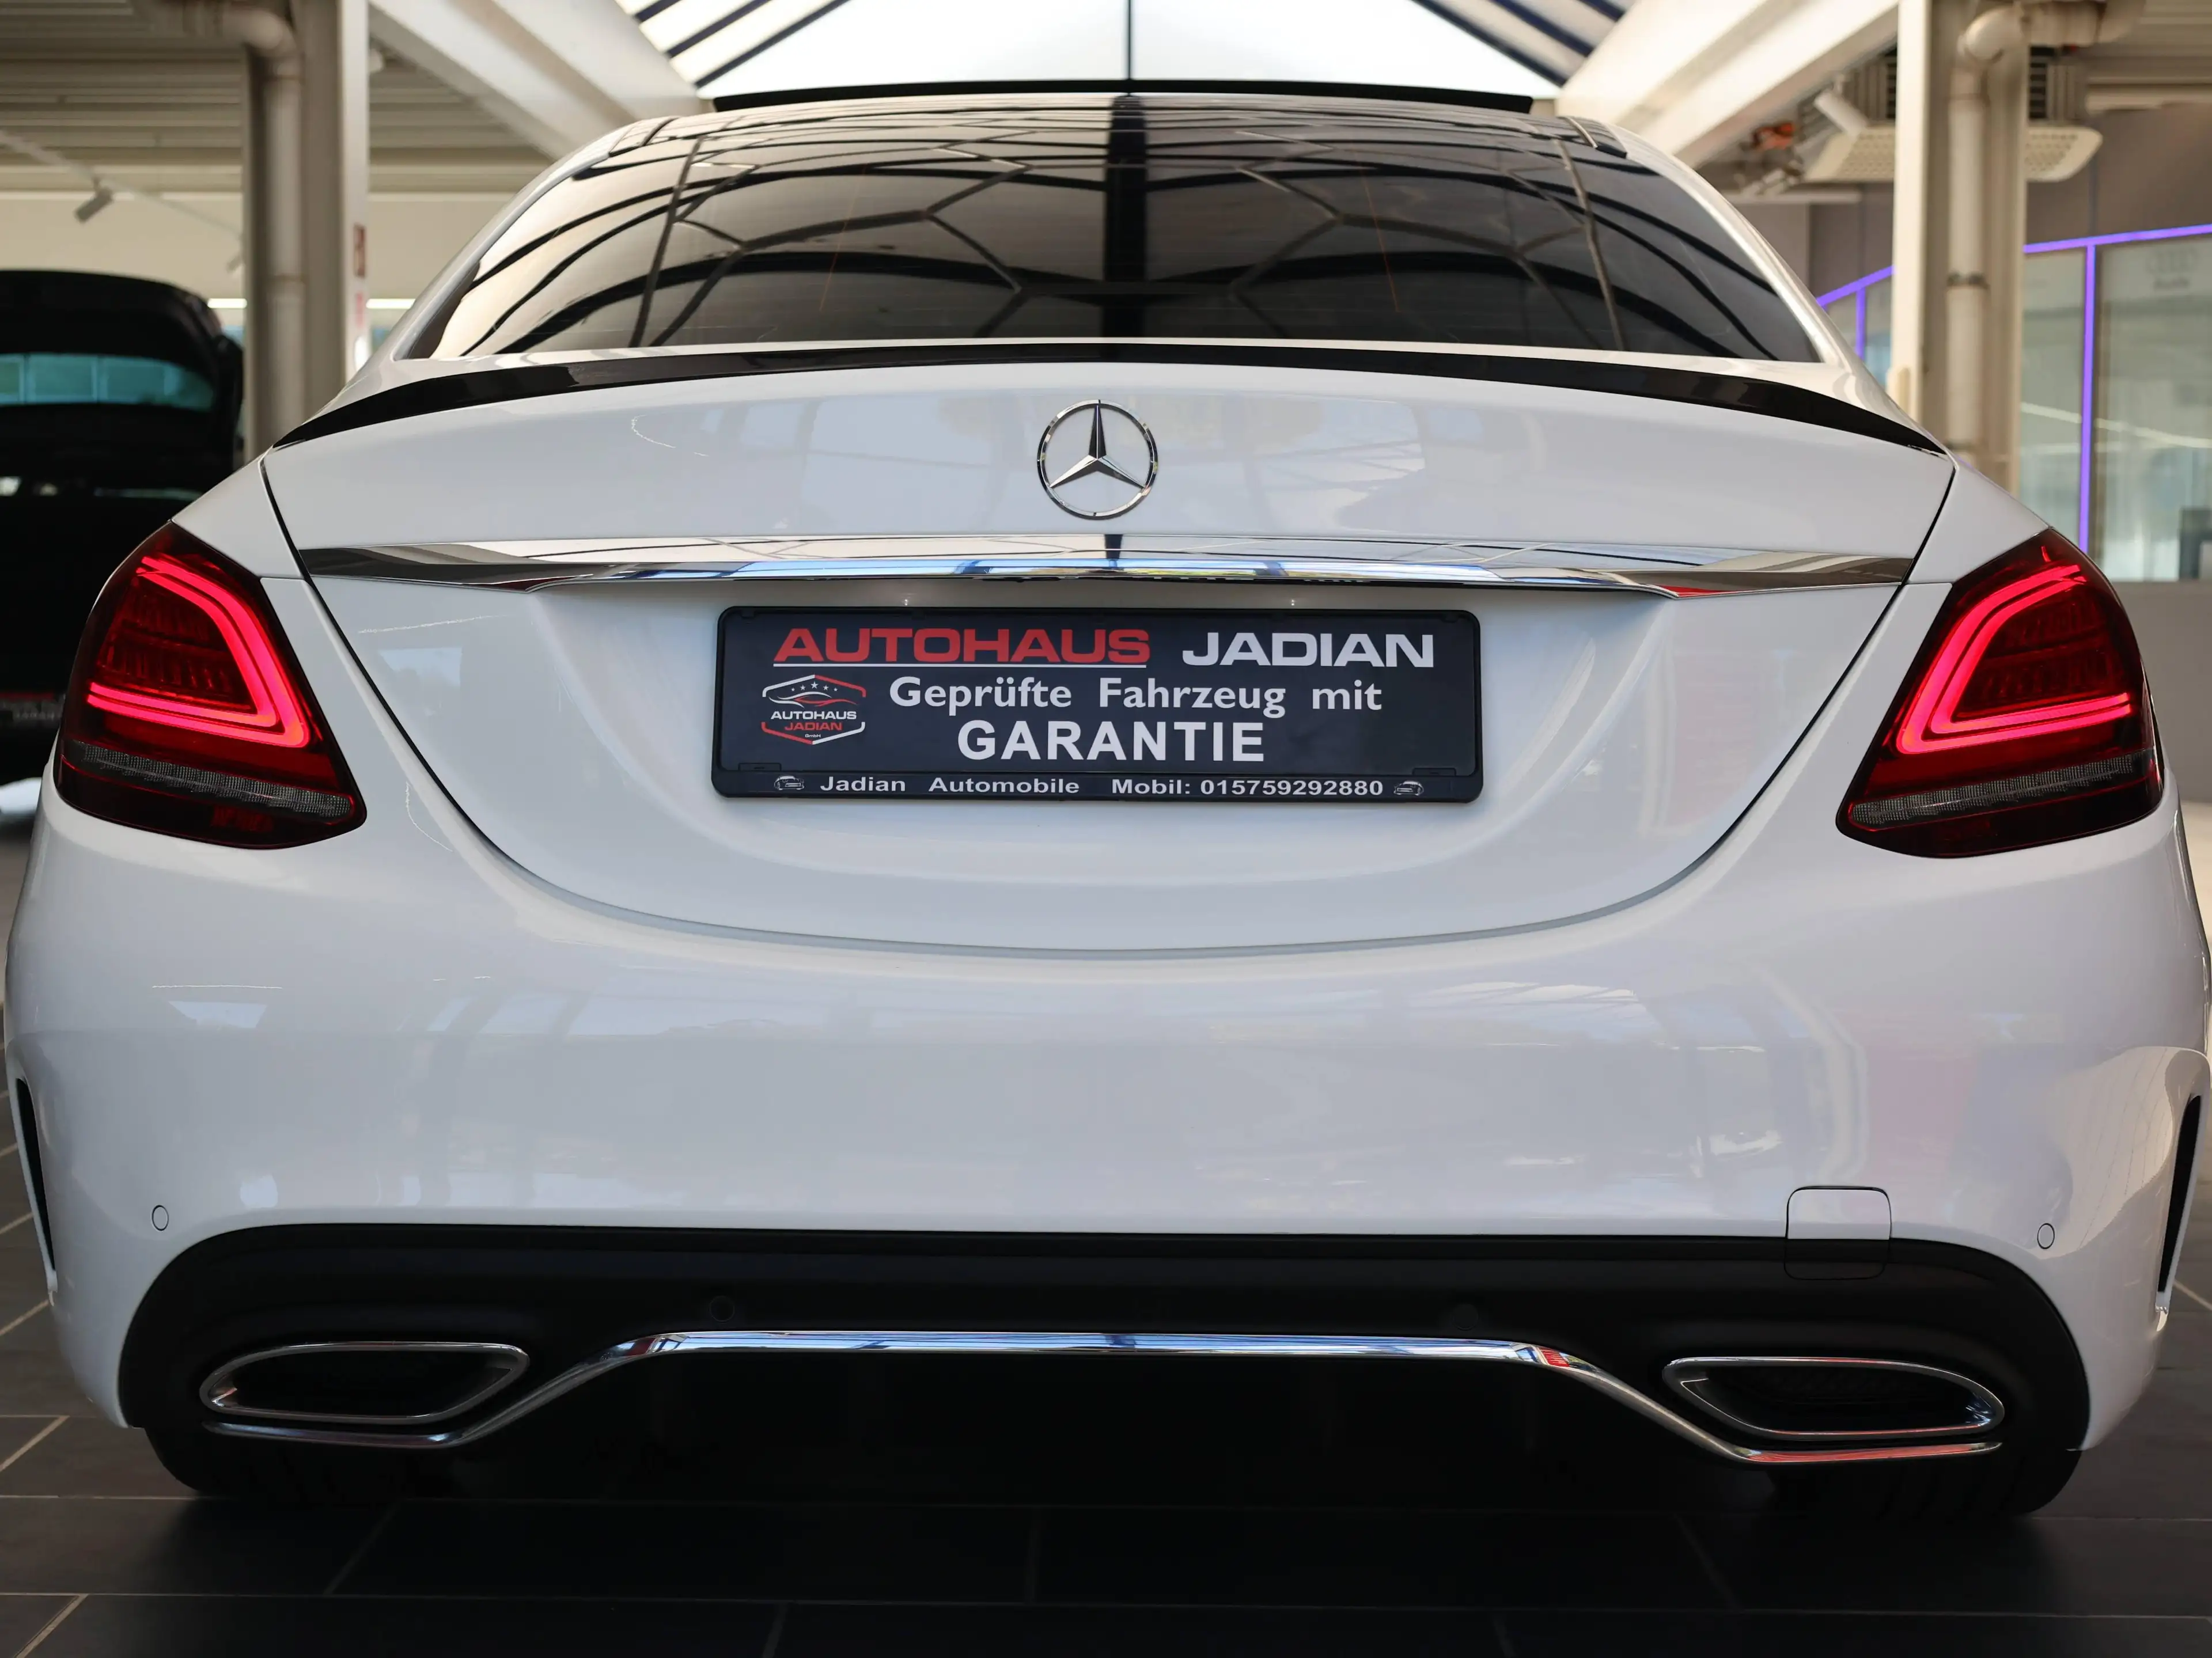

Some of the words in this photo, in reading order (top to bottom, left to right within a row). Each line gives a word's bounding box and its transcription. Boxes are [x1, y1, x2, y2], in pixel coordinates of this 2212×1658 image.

[773, 628, 1150, 663] AUTOHAUS
[1182, 632, 1434, 668] JADIAN
[889, 676, 1072, 716] Geprüfte
[1099, 677, 1286, 719] Fahrzeug
[1312, 679, 1382, 711] mit
[770, 711, 857, 720] AUTOHAUS
[785, 722, 843, 731] JADIAN
[957, 719, 1264, 762] GARANTIE
[820, 776, 906, 792] Jadian
[928, 777, 1080, 794] Automobile
[1112, 779, 1190, 795] Mobil:
[1200, 779, 1383, 796] 015759292880
